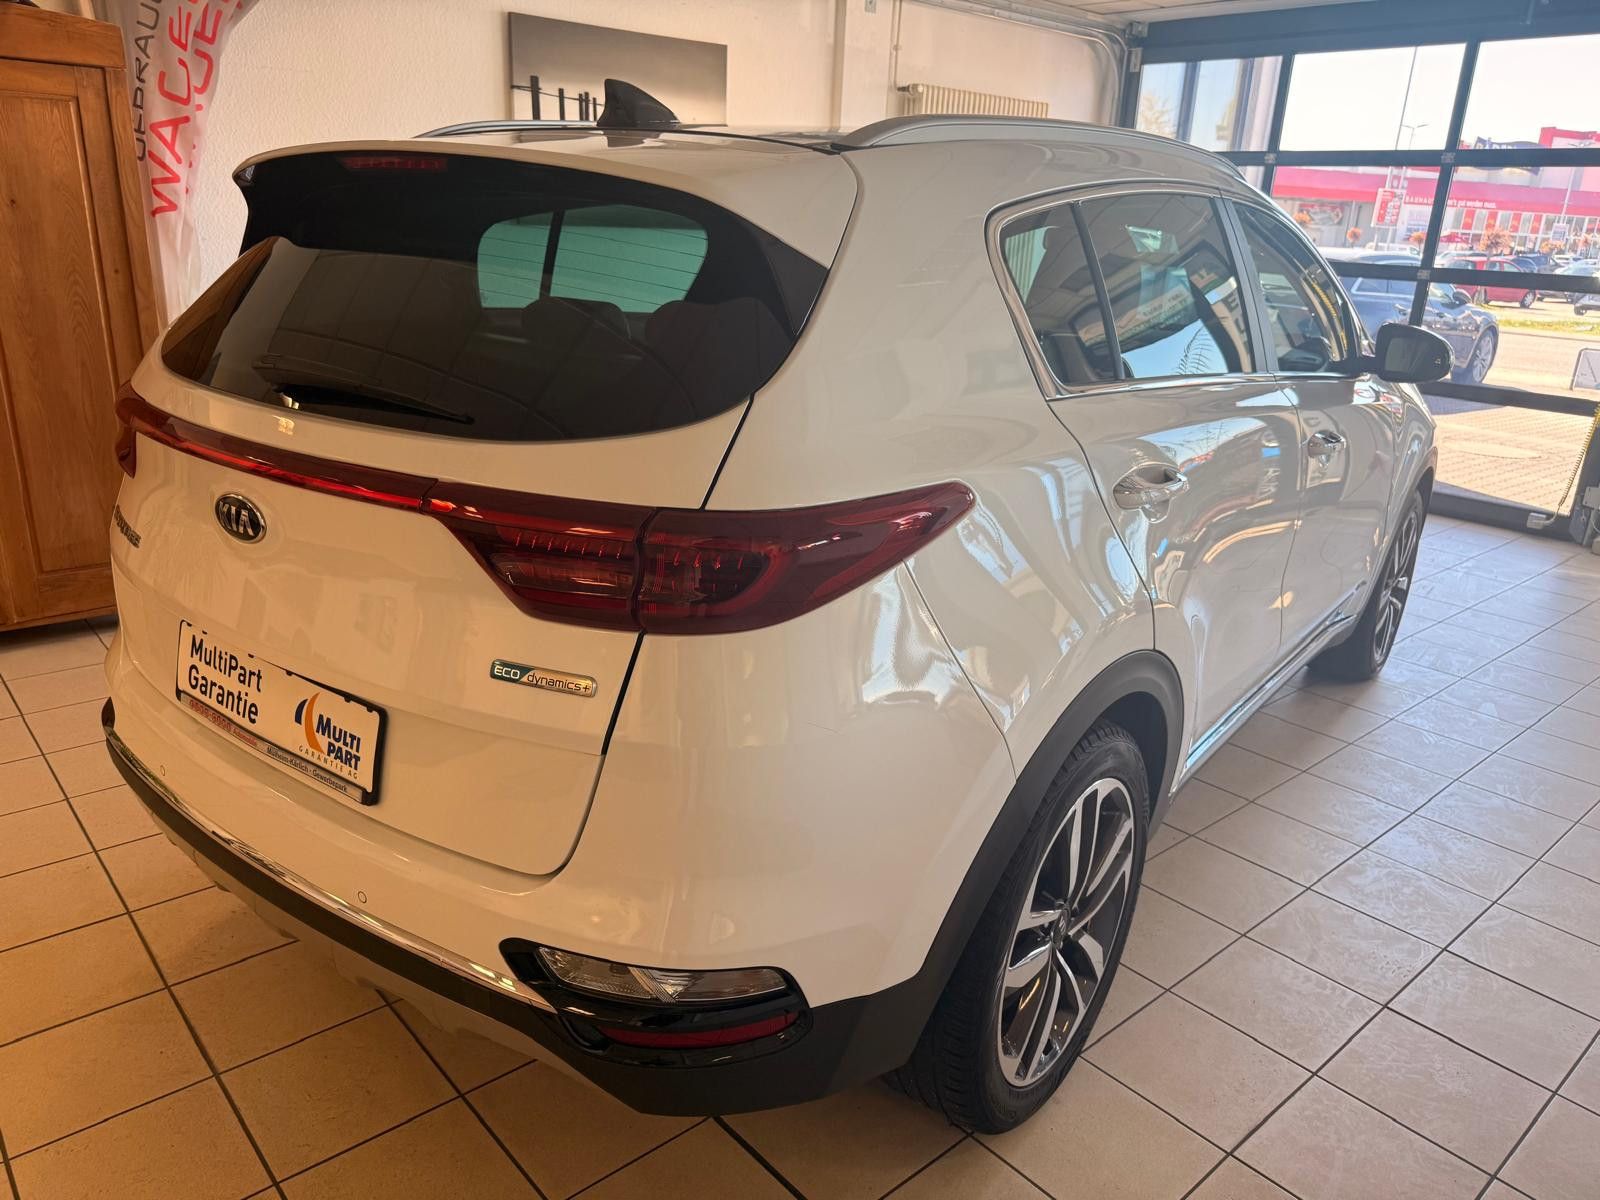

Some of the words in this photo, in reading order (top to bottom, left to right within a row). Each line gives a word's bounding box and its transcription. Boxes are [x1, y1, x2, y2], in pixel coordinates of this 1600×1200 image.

[1405, 195, 1434, 204] BAUHAU
[219, 501, 254, 536] KIA
[190, 634, 263, 693] MultiPart
[494, 665, 520, 680] ECO
[526, 672, 591, 693] dynamics+
[188, 664, 259, 724] Garantie
[316, 713, 361, 753] MULTI
[298, 745, 344, 773] GARANTIE
[347, 770, 358, 780] AG
[326, 741, 361, 771] PART
